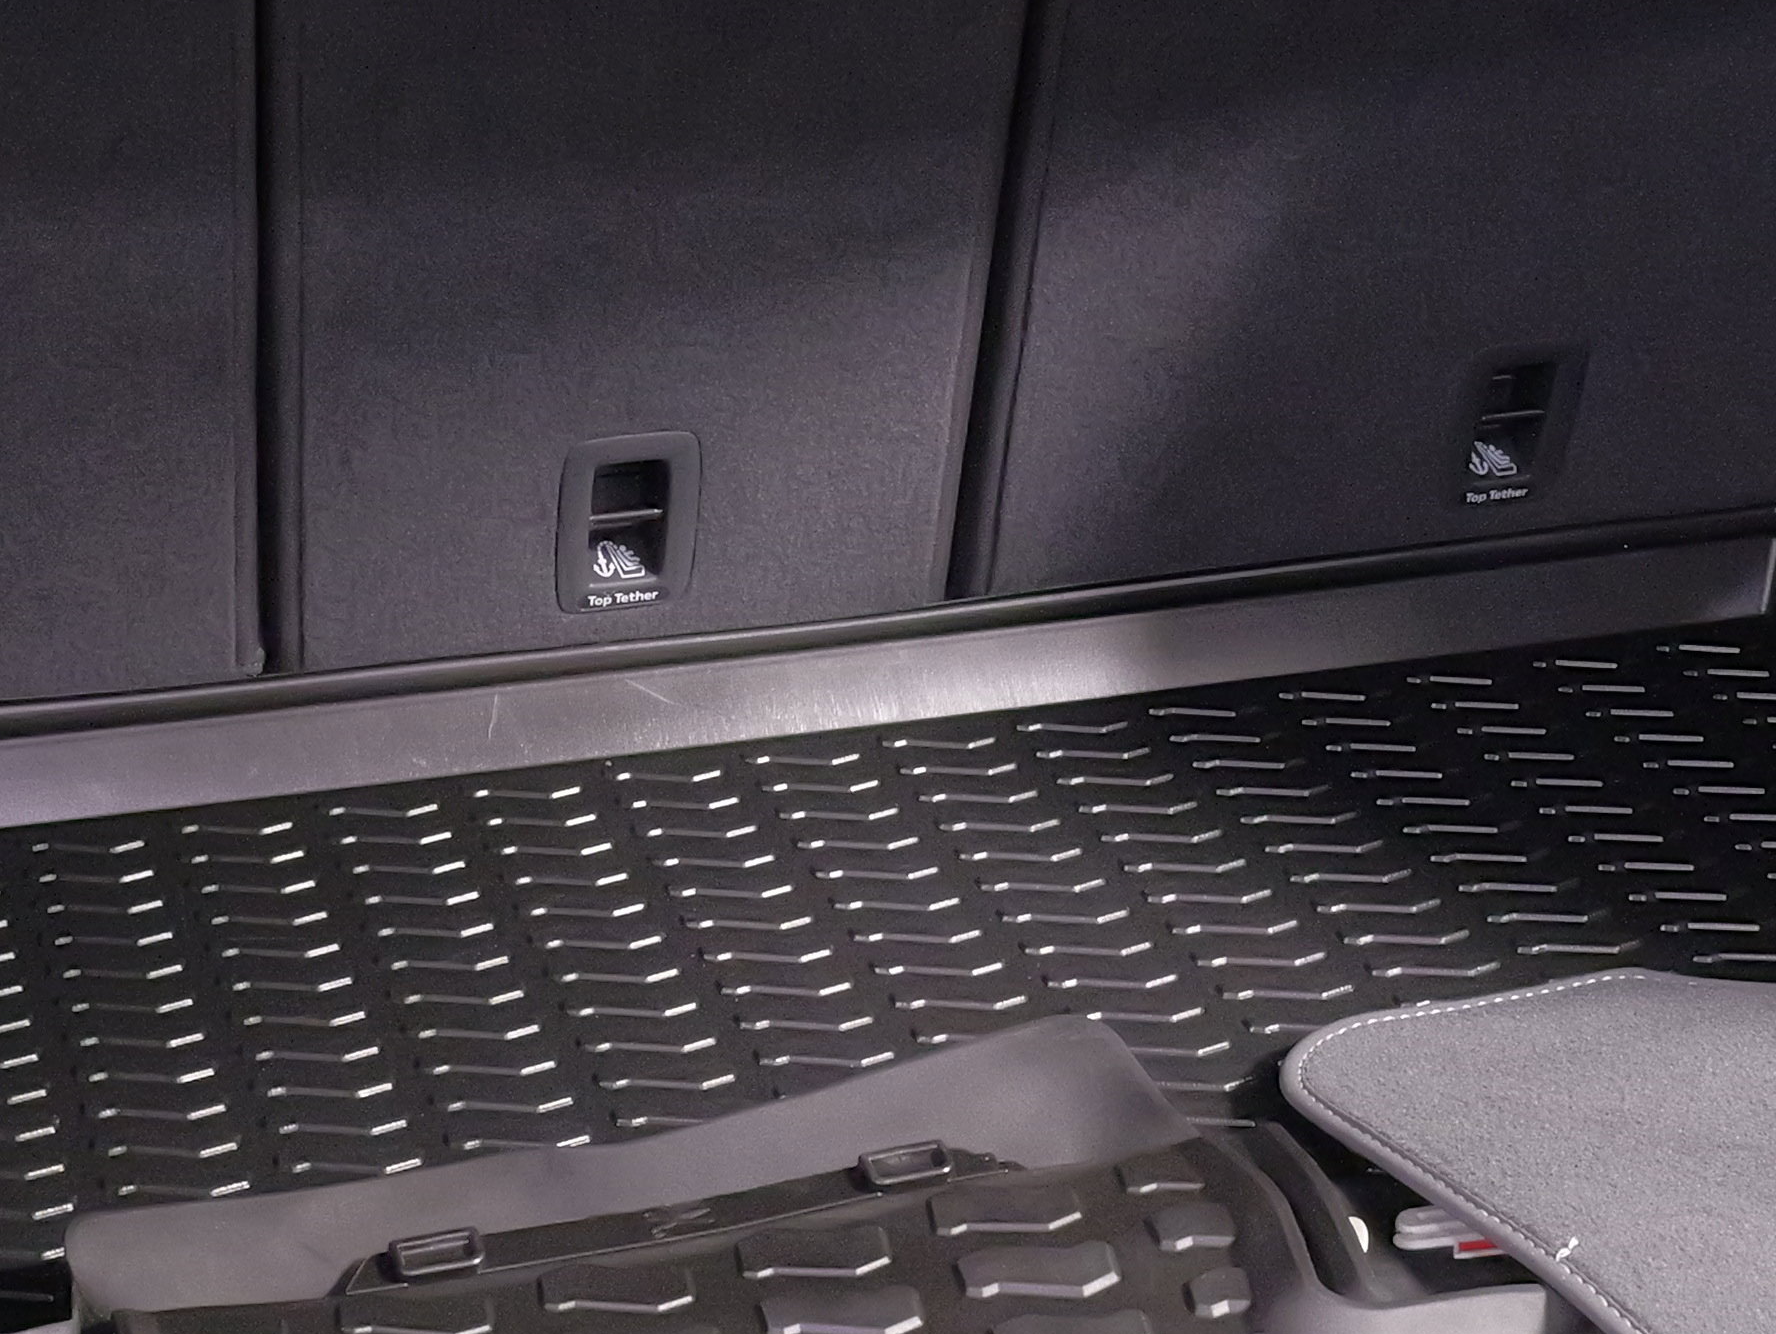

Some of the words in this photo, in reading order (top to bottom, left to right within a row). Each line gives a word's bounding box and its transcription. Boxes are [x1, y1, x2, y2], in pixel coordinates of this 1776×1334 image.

[1466, 492, 1487, 504] Top
[1488, 488, 1529, 500] Tether
[587, 595, 612, 607] Top
[614, 590, 659, 603] Tether
